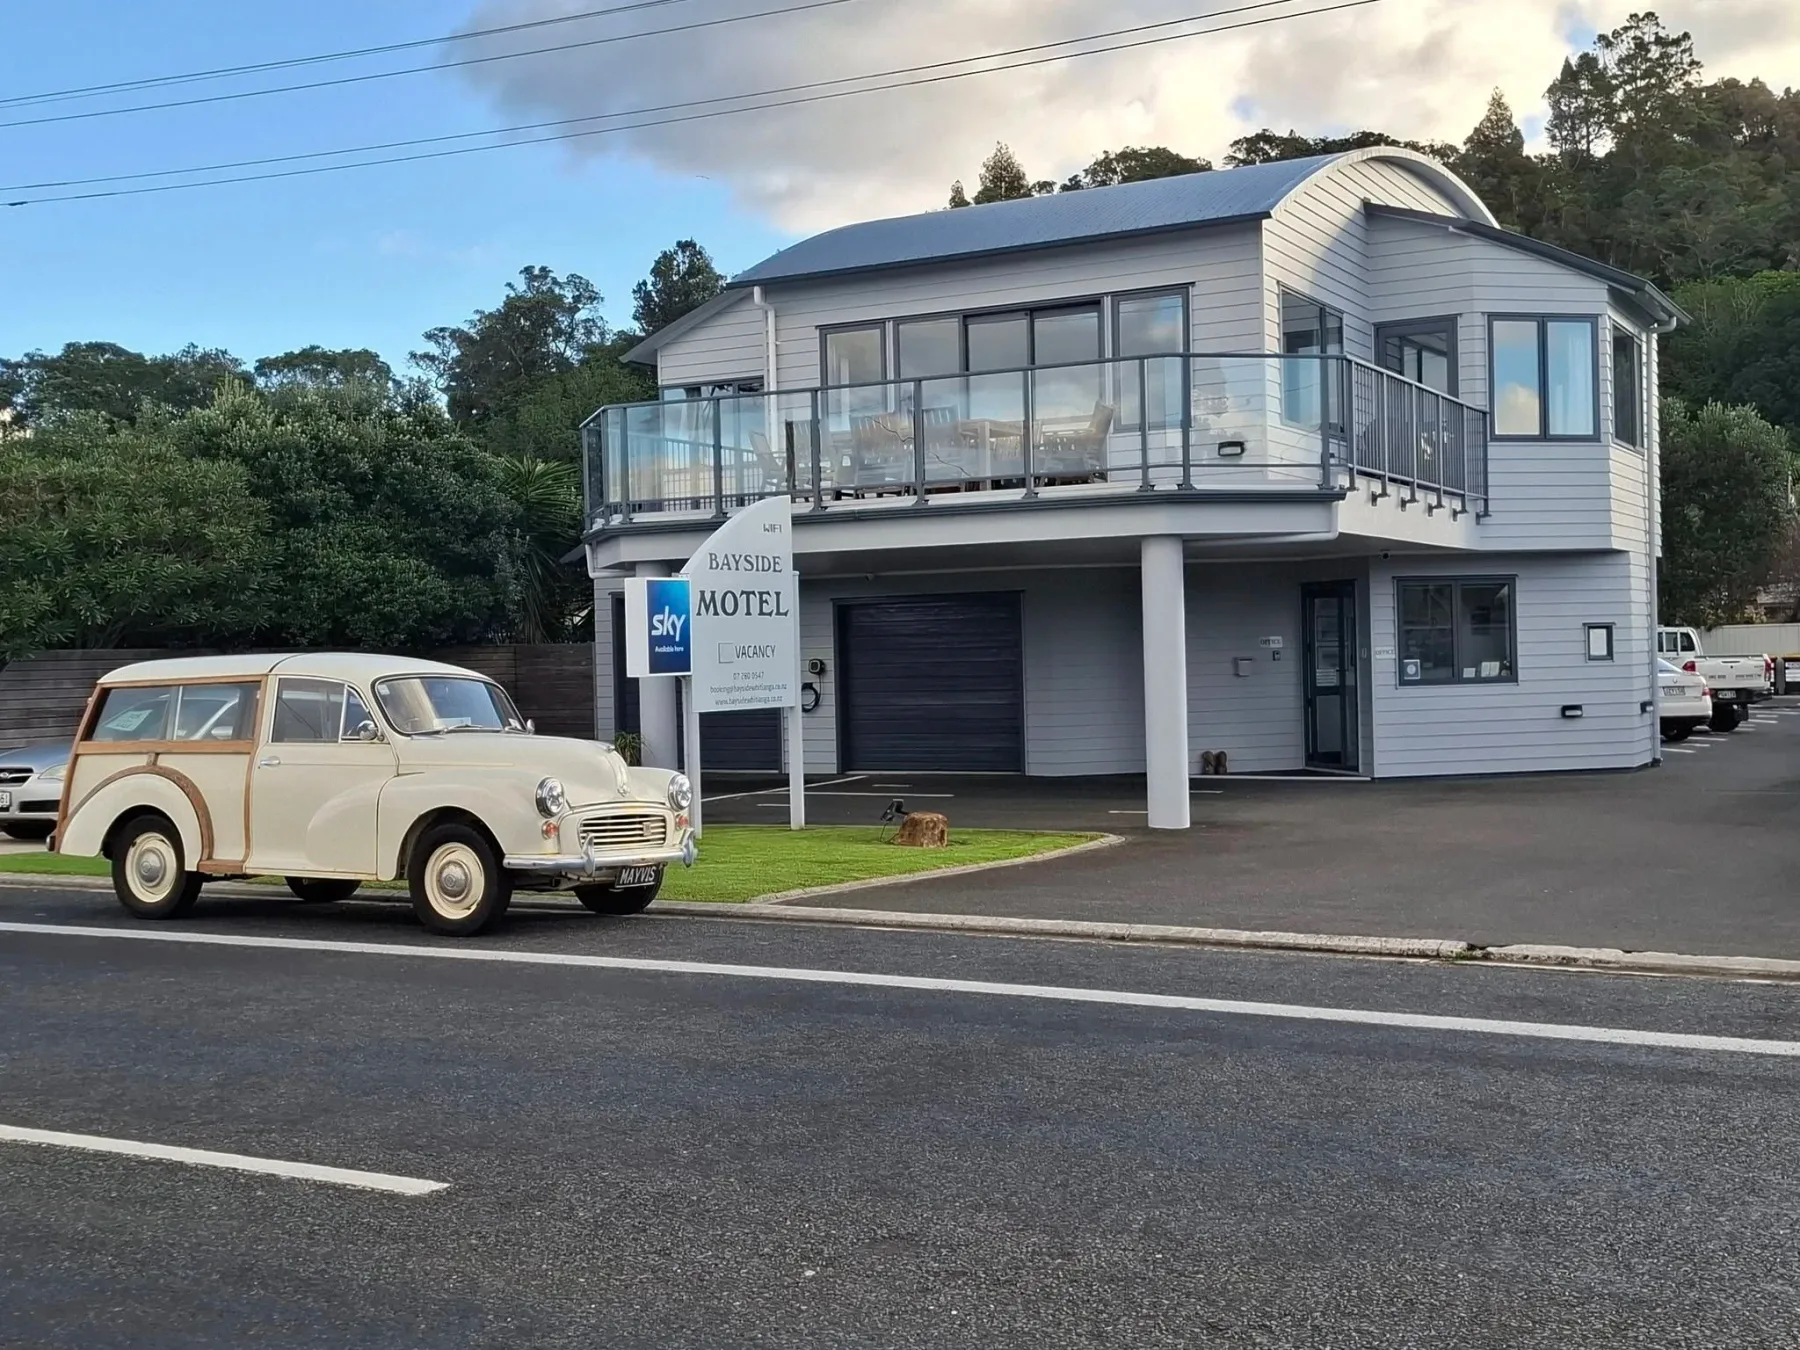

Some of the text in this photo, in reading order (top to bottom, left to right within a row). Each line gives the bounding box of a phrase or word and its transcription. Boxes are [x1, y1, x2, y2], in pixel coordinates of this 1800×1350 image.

[763, 523, 782, 533] WIFI
[708, 552, 783, 573] BAYSIDE
[696, 590, 789, 618] MOTEL
[651, 606, 686, 642] sky
[735, 645, 776, 659] VACANCY
[620, 866, 657, 884] MAYVIS
